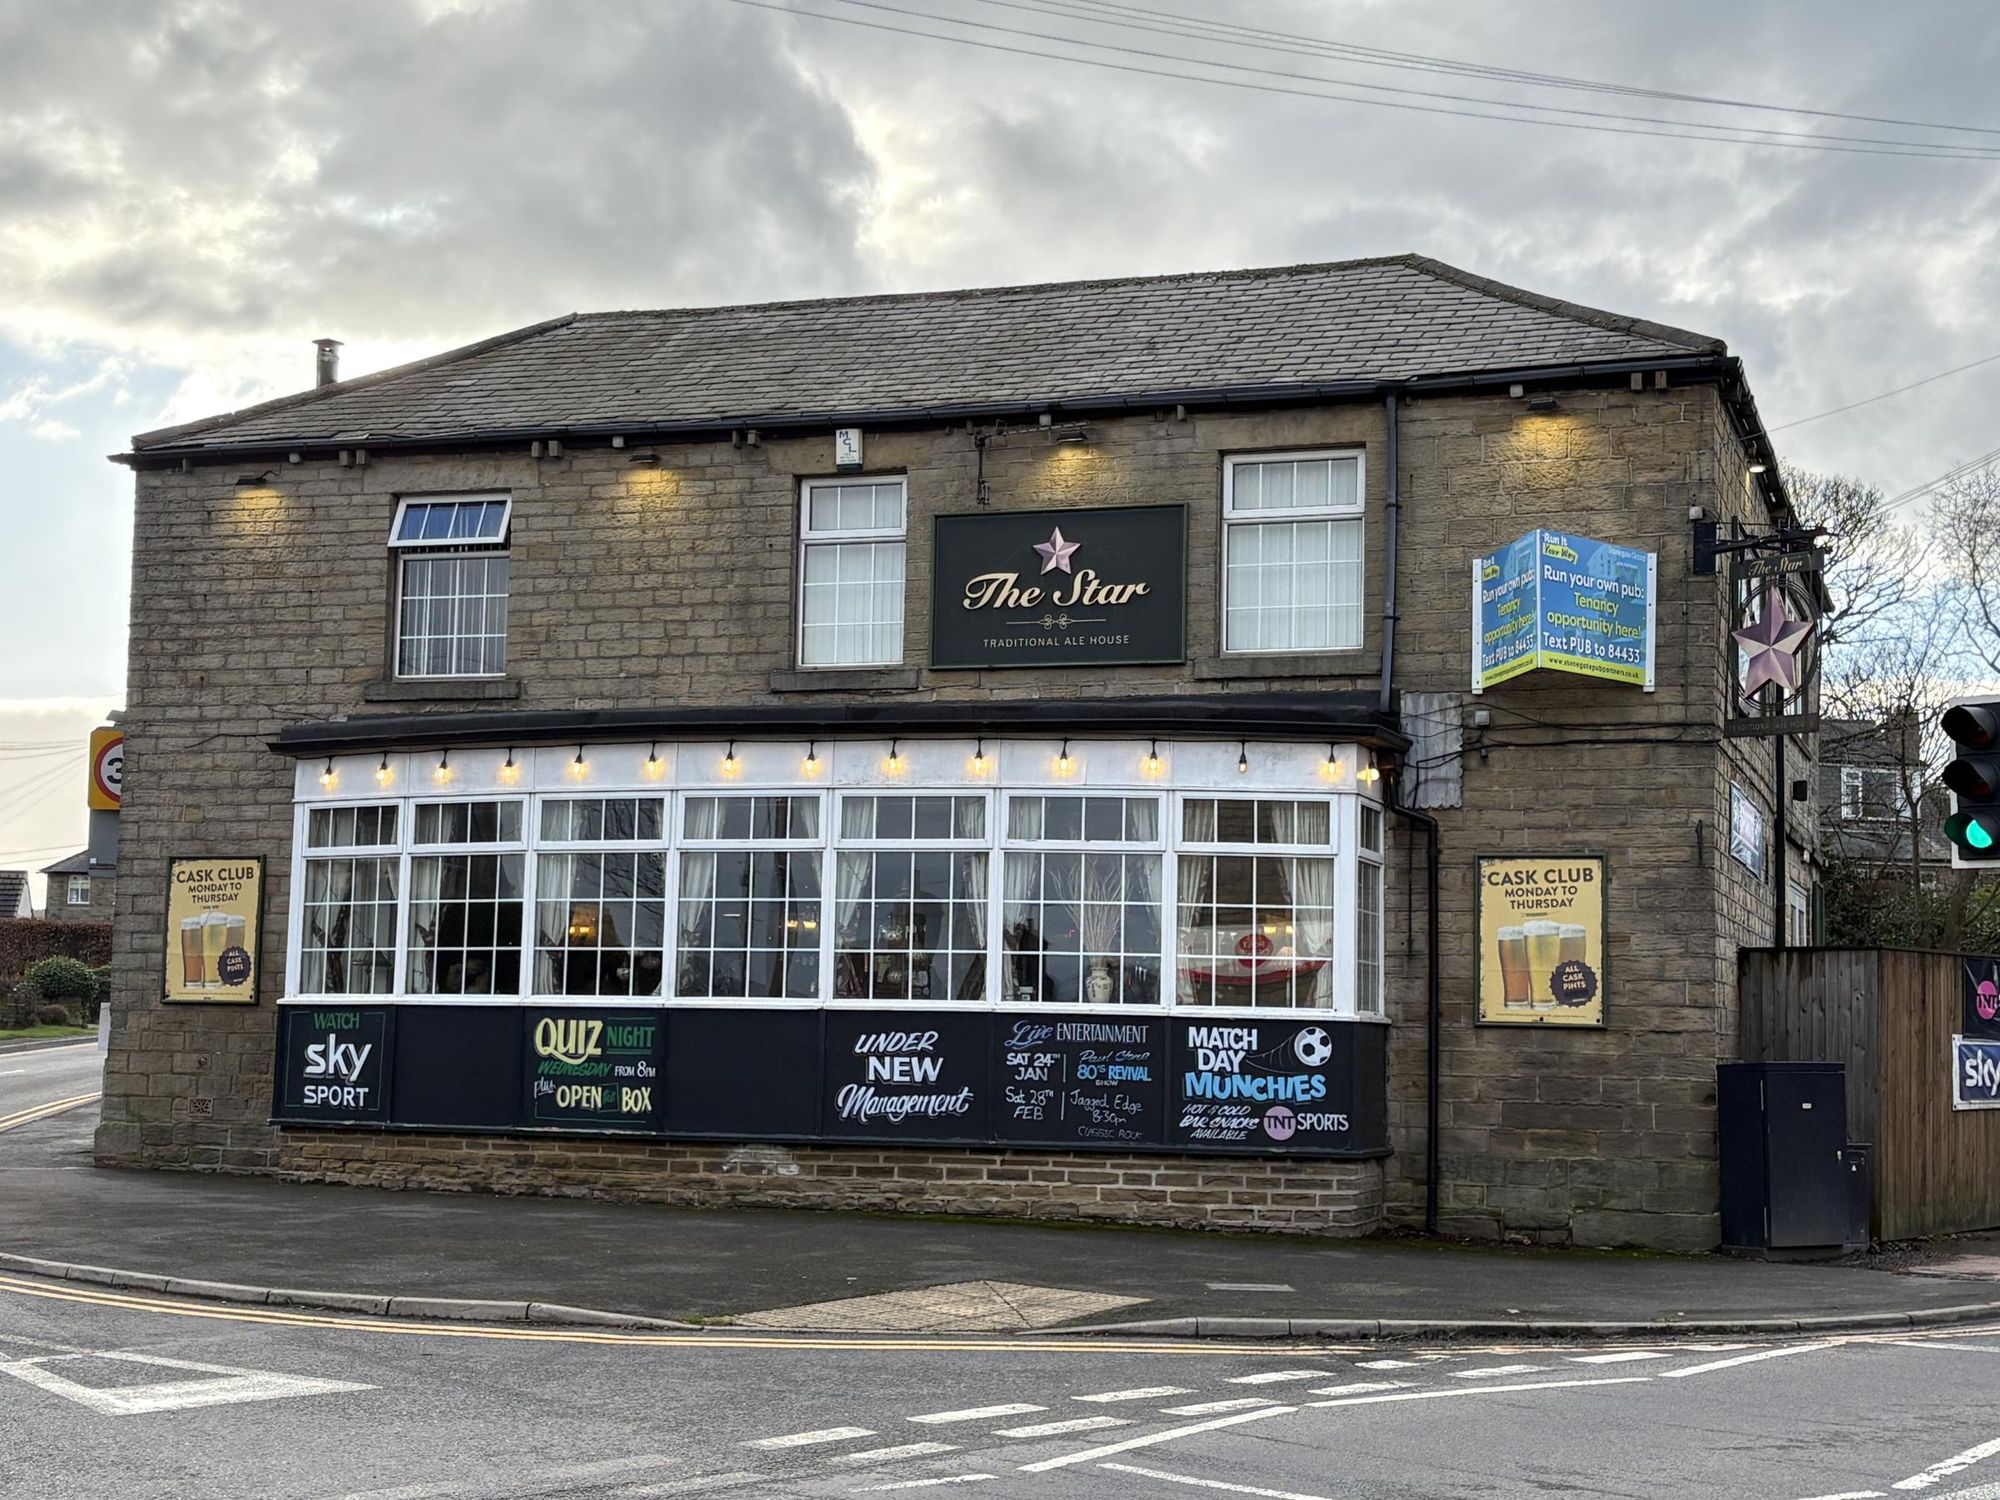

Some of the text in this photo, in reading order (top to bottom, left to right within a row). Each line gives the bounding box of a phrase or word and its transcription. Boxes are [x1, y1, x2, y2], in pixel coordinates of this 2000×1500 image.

[1544, 532, 1560, 544] Run
[1544, 543, 1577, 561] Your Way
[1748, 556, 1803, 576] The Star
[963, 569, 1151, 610] The Star
[1483, 587, 1496, 604] Run
[1495, 581, 1508, 600] your
[1508, 575, 1521, 592] own
[1544, 564, 1645, 599] Run your own pub:
[1497, 597, 1521, 619] Tenancy
[1574, 591, 1619, 617] Tenancy
[1484, 618, 1518, 646] opportunity
[1547, 611, 1641, 639] opportunity here!
[983, 635, 1131, 648] TRADITIONAL ALE HOUSE
[1495, 645, 1508, 662] PUB
[1515, 634, 1534, 654] 84433
[1543, 631, 1640, 663] Text PUB to 84433
[107, 757, 123, 785] 3
[176, 866, 255, 884] CASK CLUB
[1487, 867, 1595, 887] CASK CLUB
[188, 882, 243, 894] MONDAY TO
[192, 892, 240, 904] THURSDAY
[1504, 885, 1578, 899] MONDAY TO
[1510, 897, 1575, 910] THURSDAY
[1562, 972, 1585, 982] CASK
[1565, 965, 1580, 973] ALL
[1563, 981, 1587, 991] PINTS
[314, 1012, 360, 1030] WATCH
[535, 1017, 604, 1065] QUIZ
[607, 1026, 656, 1048] NIGHT
[854, 1030, 939, 1054] UNDER
[1004, 1019, 1150, 1049] Live ENTERTAINMENT
[1188, 1026, 1258, 1051] MATCH
[304, 1033, 373, 1083] sky
[1006, 1052, 1031, 1066] SAT
[1079, 1049, 1114, 1064] Paul
[1197, 1048, 1246, 1073] DAY
[537, 1060, 656, 1078] WEDNESDAY FROM 8PM
[868, 1056, 944, 1082] NEW
[1014, 1067, 1049, 1081] JAN
[1108, 1065, 1152, 1082] REVIVAL
[1965, 1049, 2000, 1097] sky
[304, 1085, 369, 1107] SPORT
[534, 1076, 557, 1099] plus
[556, 1085, 603, 1109] OPEN
[621, 1086, 653, 1113] BOX
[1005, 1086, 1027, 1104] Sat
[1184, 1072, 1327, 1102] MUNCHIES
[837, 1084, 975, 1122] Management
[1070, 1089, 1143, 1115] Jagged Edge
[1182, 1103, 1252, 1116] HOT & COLD
[1013, 1106, 1043, 1120] FEB
[1179, 1116, 1260, 1130] BAR SNACKS
[1264, 1113, 1350, 1131] TNT SPORTS
[1118, 1129, 1144, 1140] ROCK
[1190, 1128, 1249, 1140] AVAILABLE
